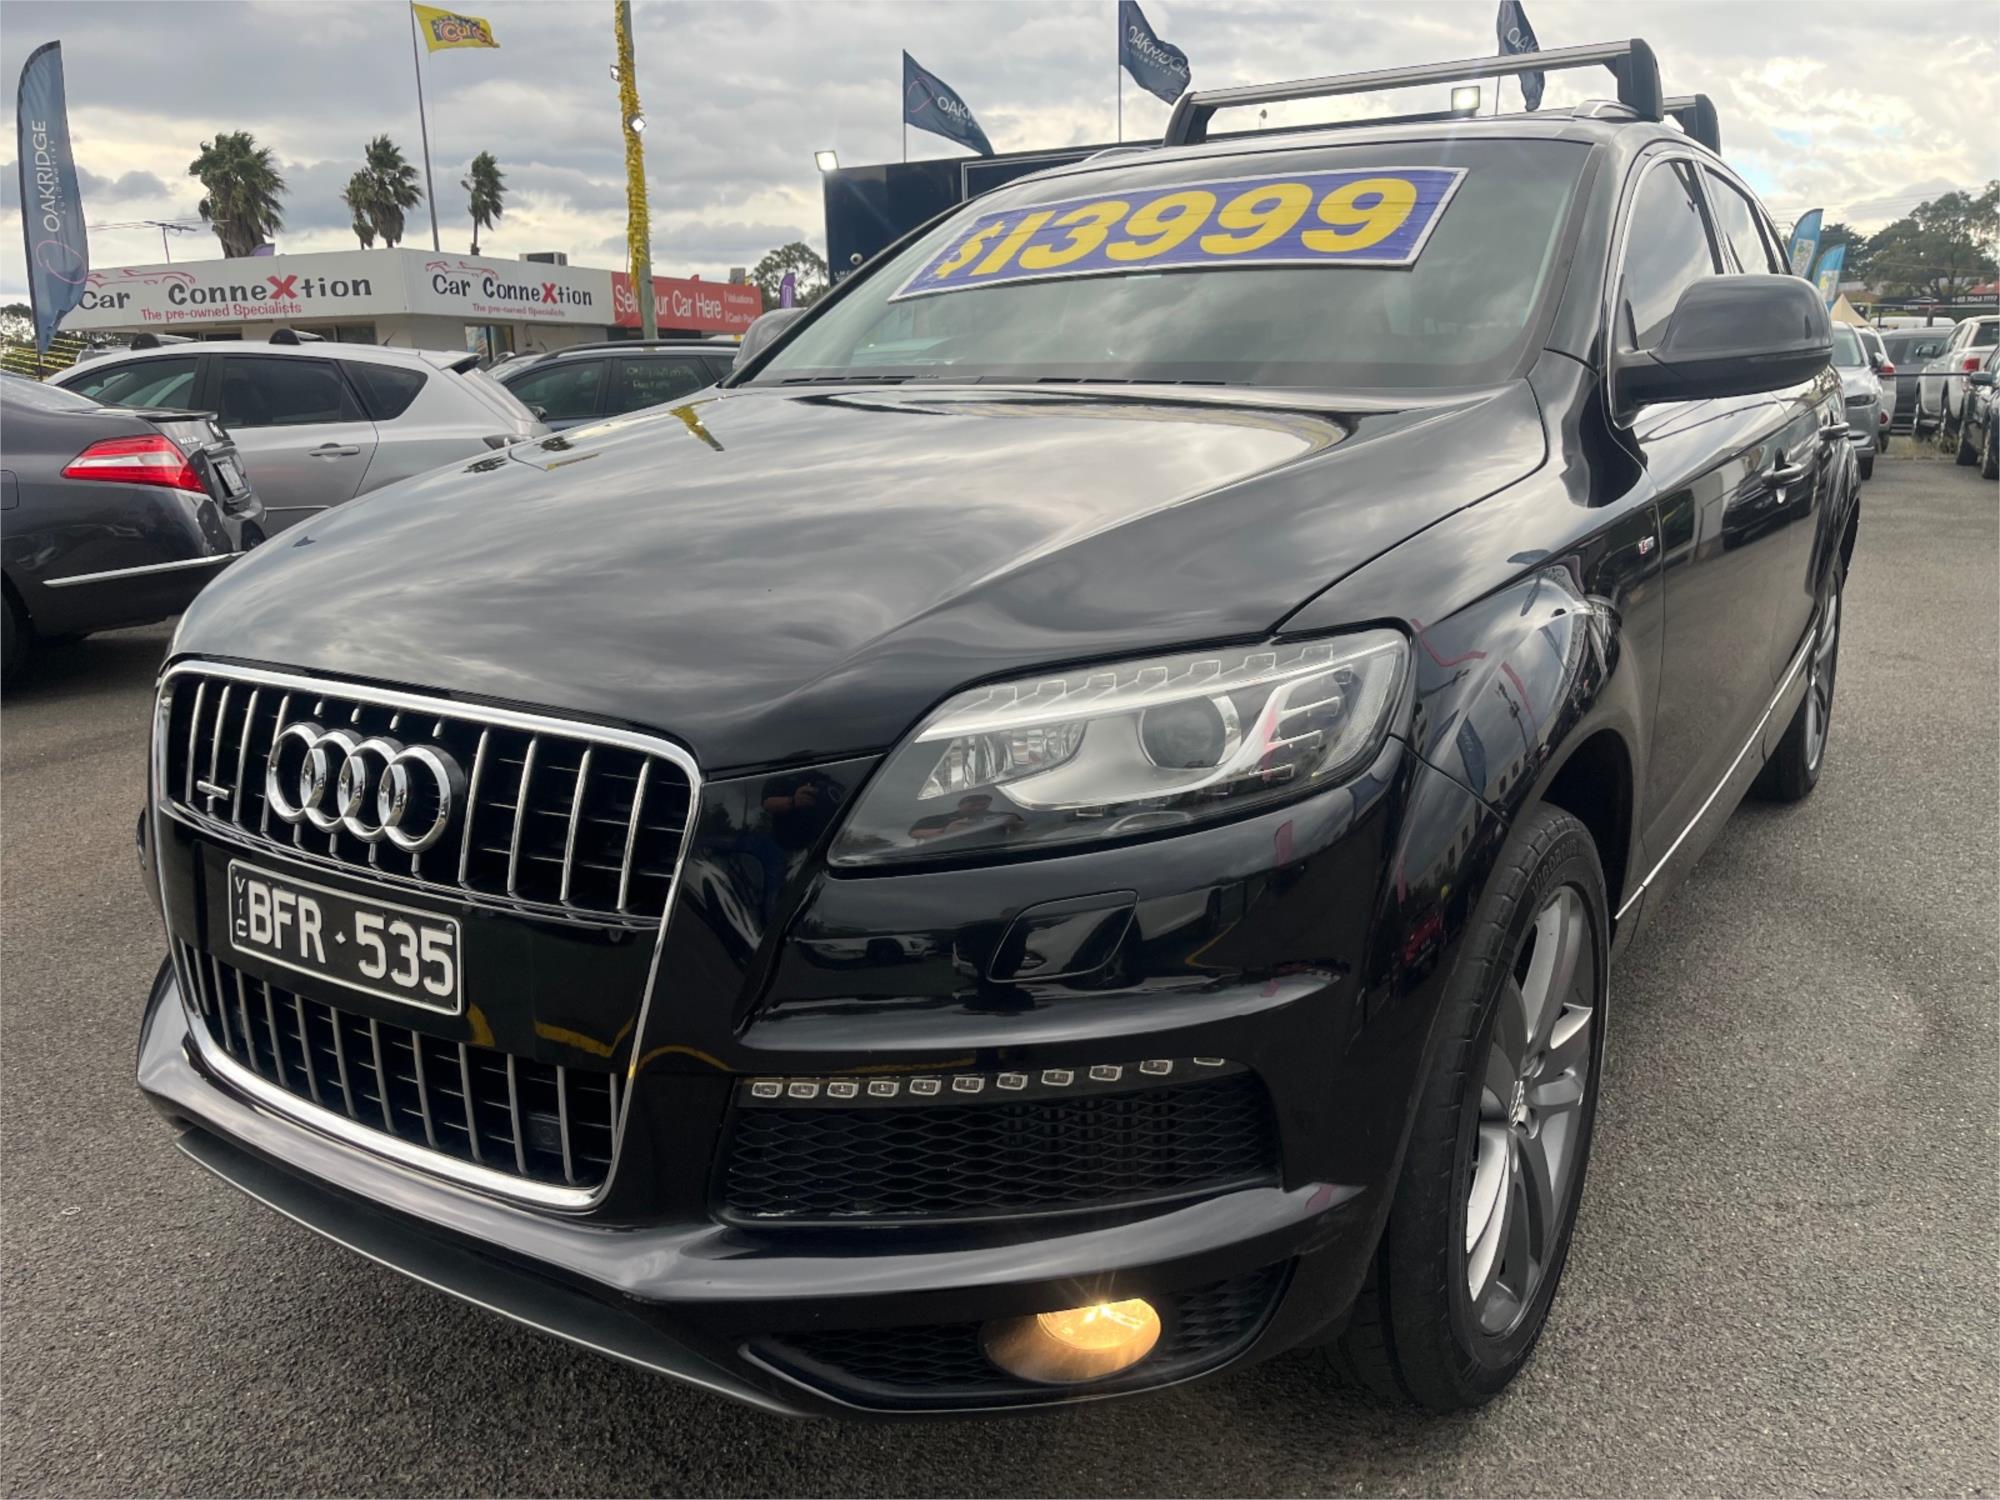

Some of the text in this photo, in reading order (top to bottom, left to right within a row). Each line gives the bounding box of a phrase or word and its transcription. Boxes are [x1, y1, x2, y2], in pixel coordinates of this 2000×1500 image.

[32, 120, 61, 232] OAKRIDGE
[935, 178, 1417, 280] $13999
[79, 275, 372, 310] Car ConneXtion
[433, 274, 592, 306] Car ConneXtion
[672, 290, 692, 317] Car
[696, 292, 722, 319] Here
[141, 301, 302, 323] The pre-owned Specialists
